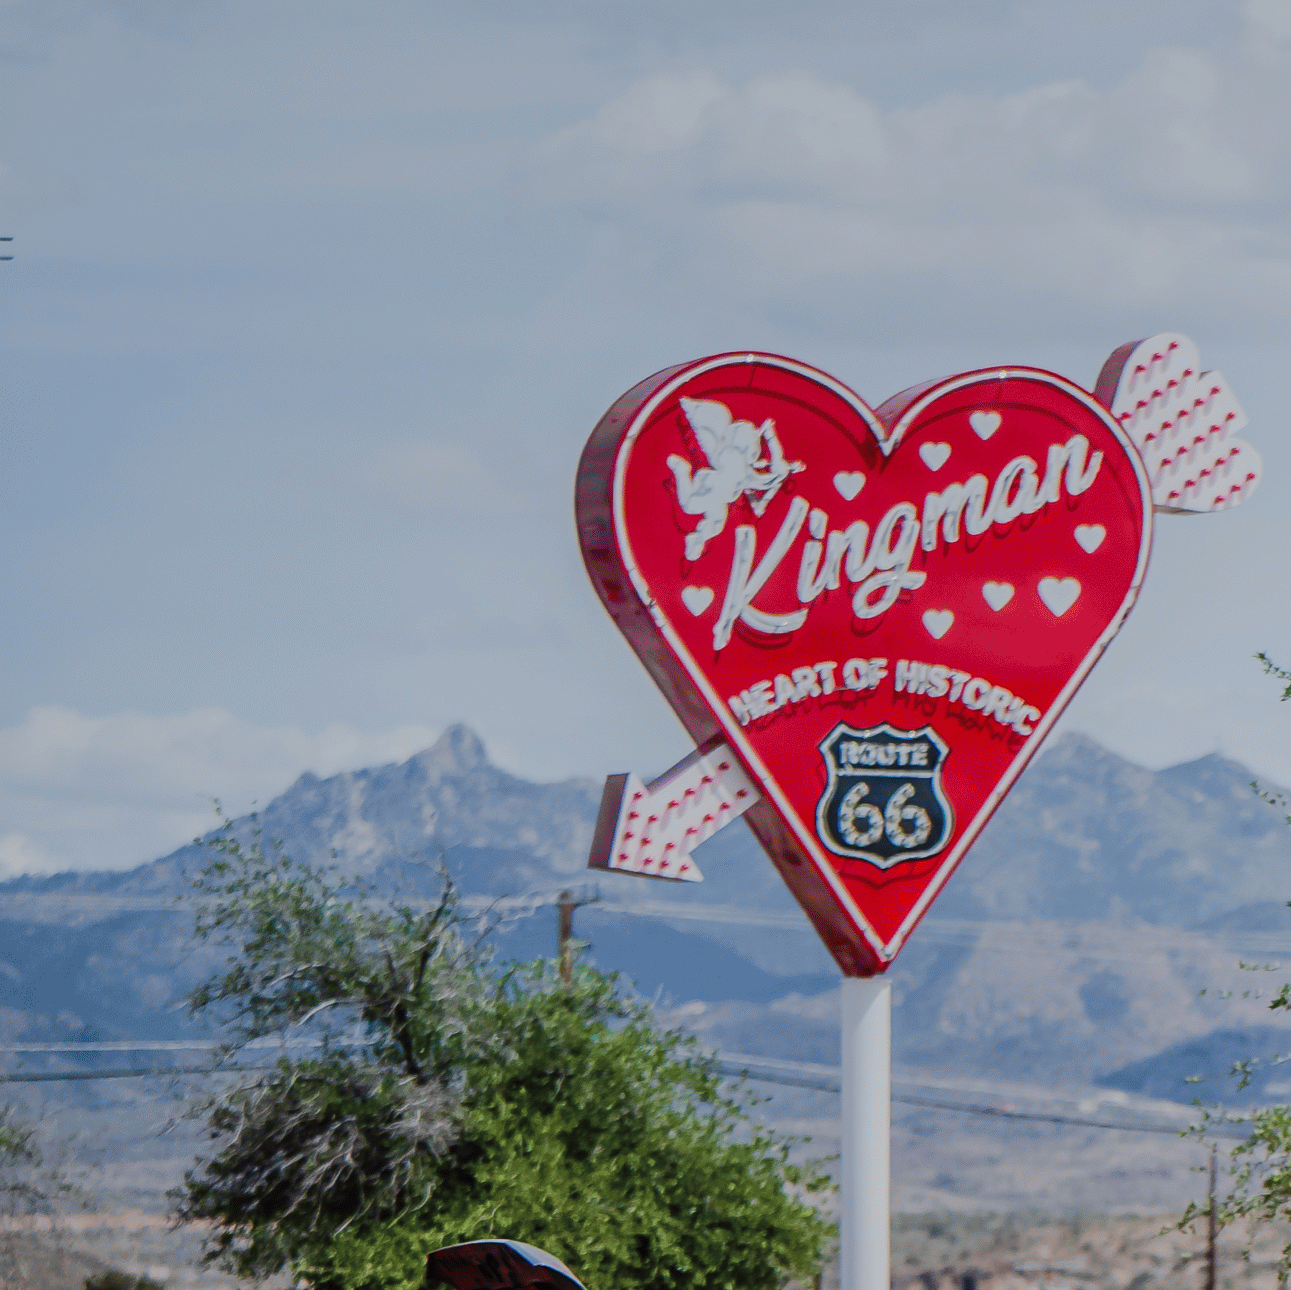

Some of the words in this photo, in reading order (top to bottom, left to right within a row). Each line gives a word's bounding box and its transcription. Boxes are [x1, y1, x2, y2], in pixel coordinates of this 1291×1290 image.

[712, 434, 1103, 651] Kingman
[728, 660, 837, 726] HEART
[842, 657, 888, 690] OF
[895, 659, 1041, 736] HISTORIC
[839, 740, 929, 766] ROUTE
[838, 781, 931, 848] 66
